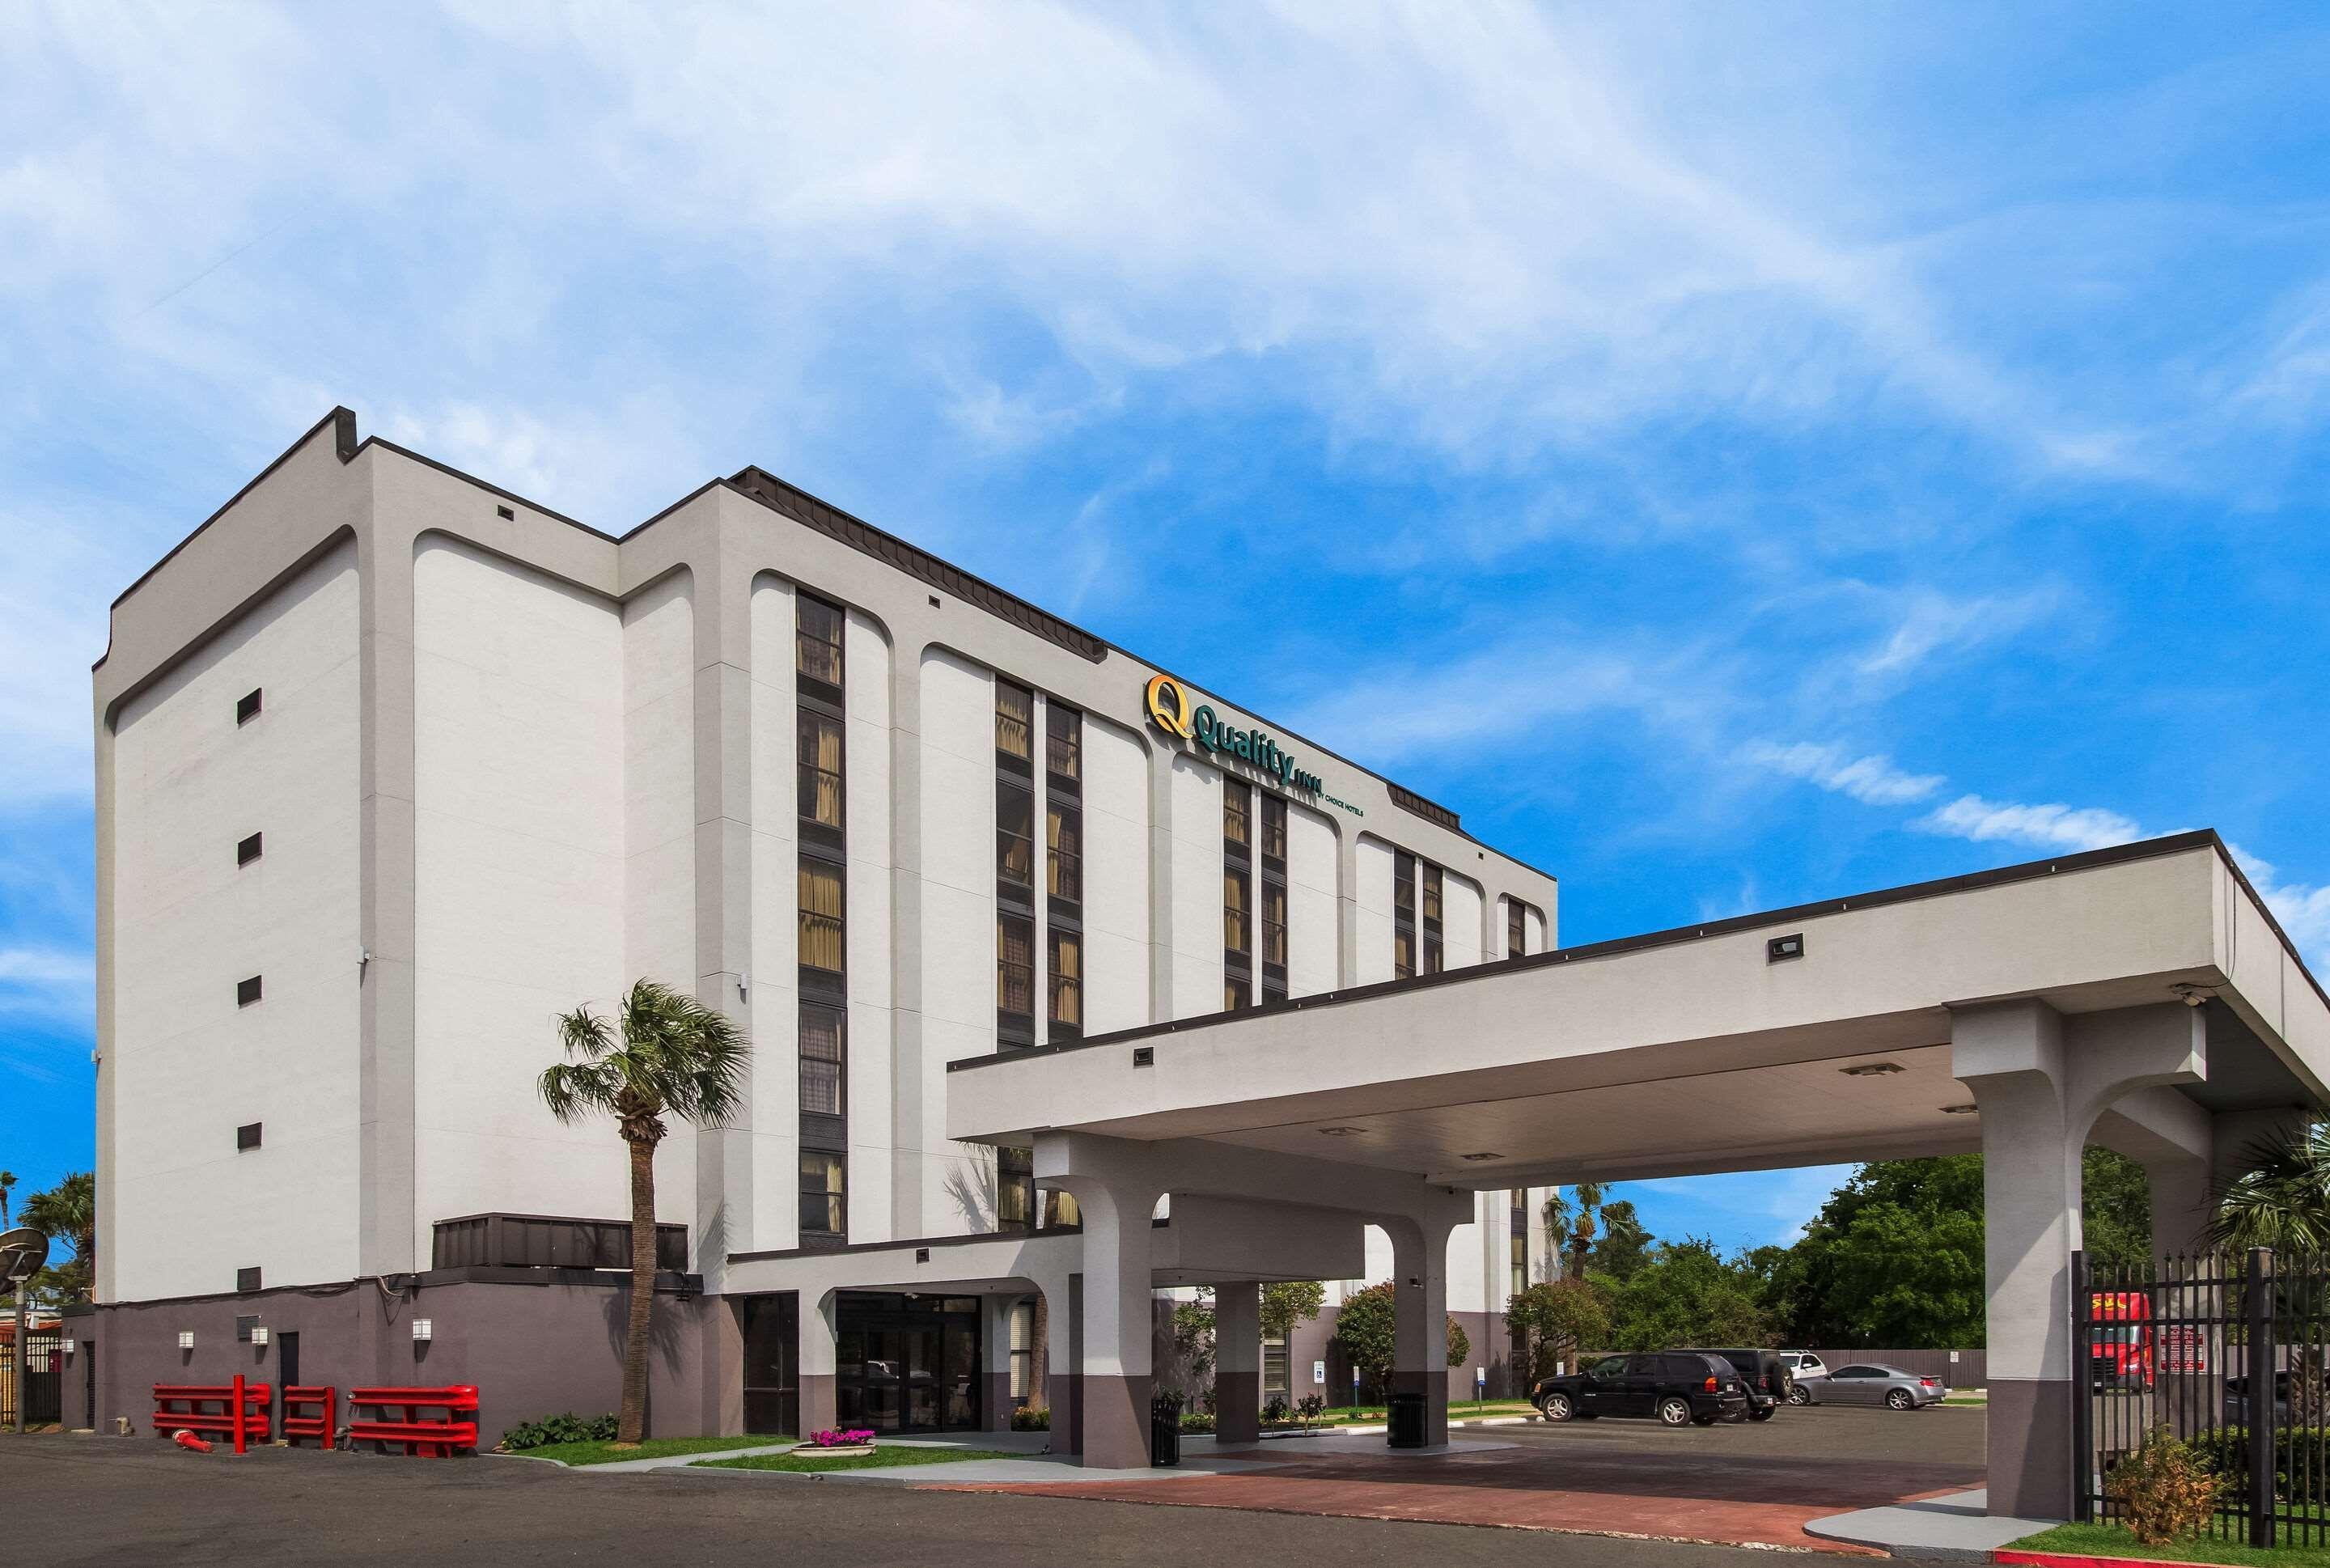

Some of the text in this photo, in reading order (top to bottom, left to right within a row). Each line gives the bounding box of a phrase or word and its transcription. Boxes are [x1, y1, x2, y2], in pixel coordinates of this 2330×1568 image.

[1143, 674, 1193, 740] Q
[1193, 704, 1322, 793] Quality INN
[1324, 795, 1345, 810] CHOICE
[1344, 803, 1365, 817] HOTELS
